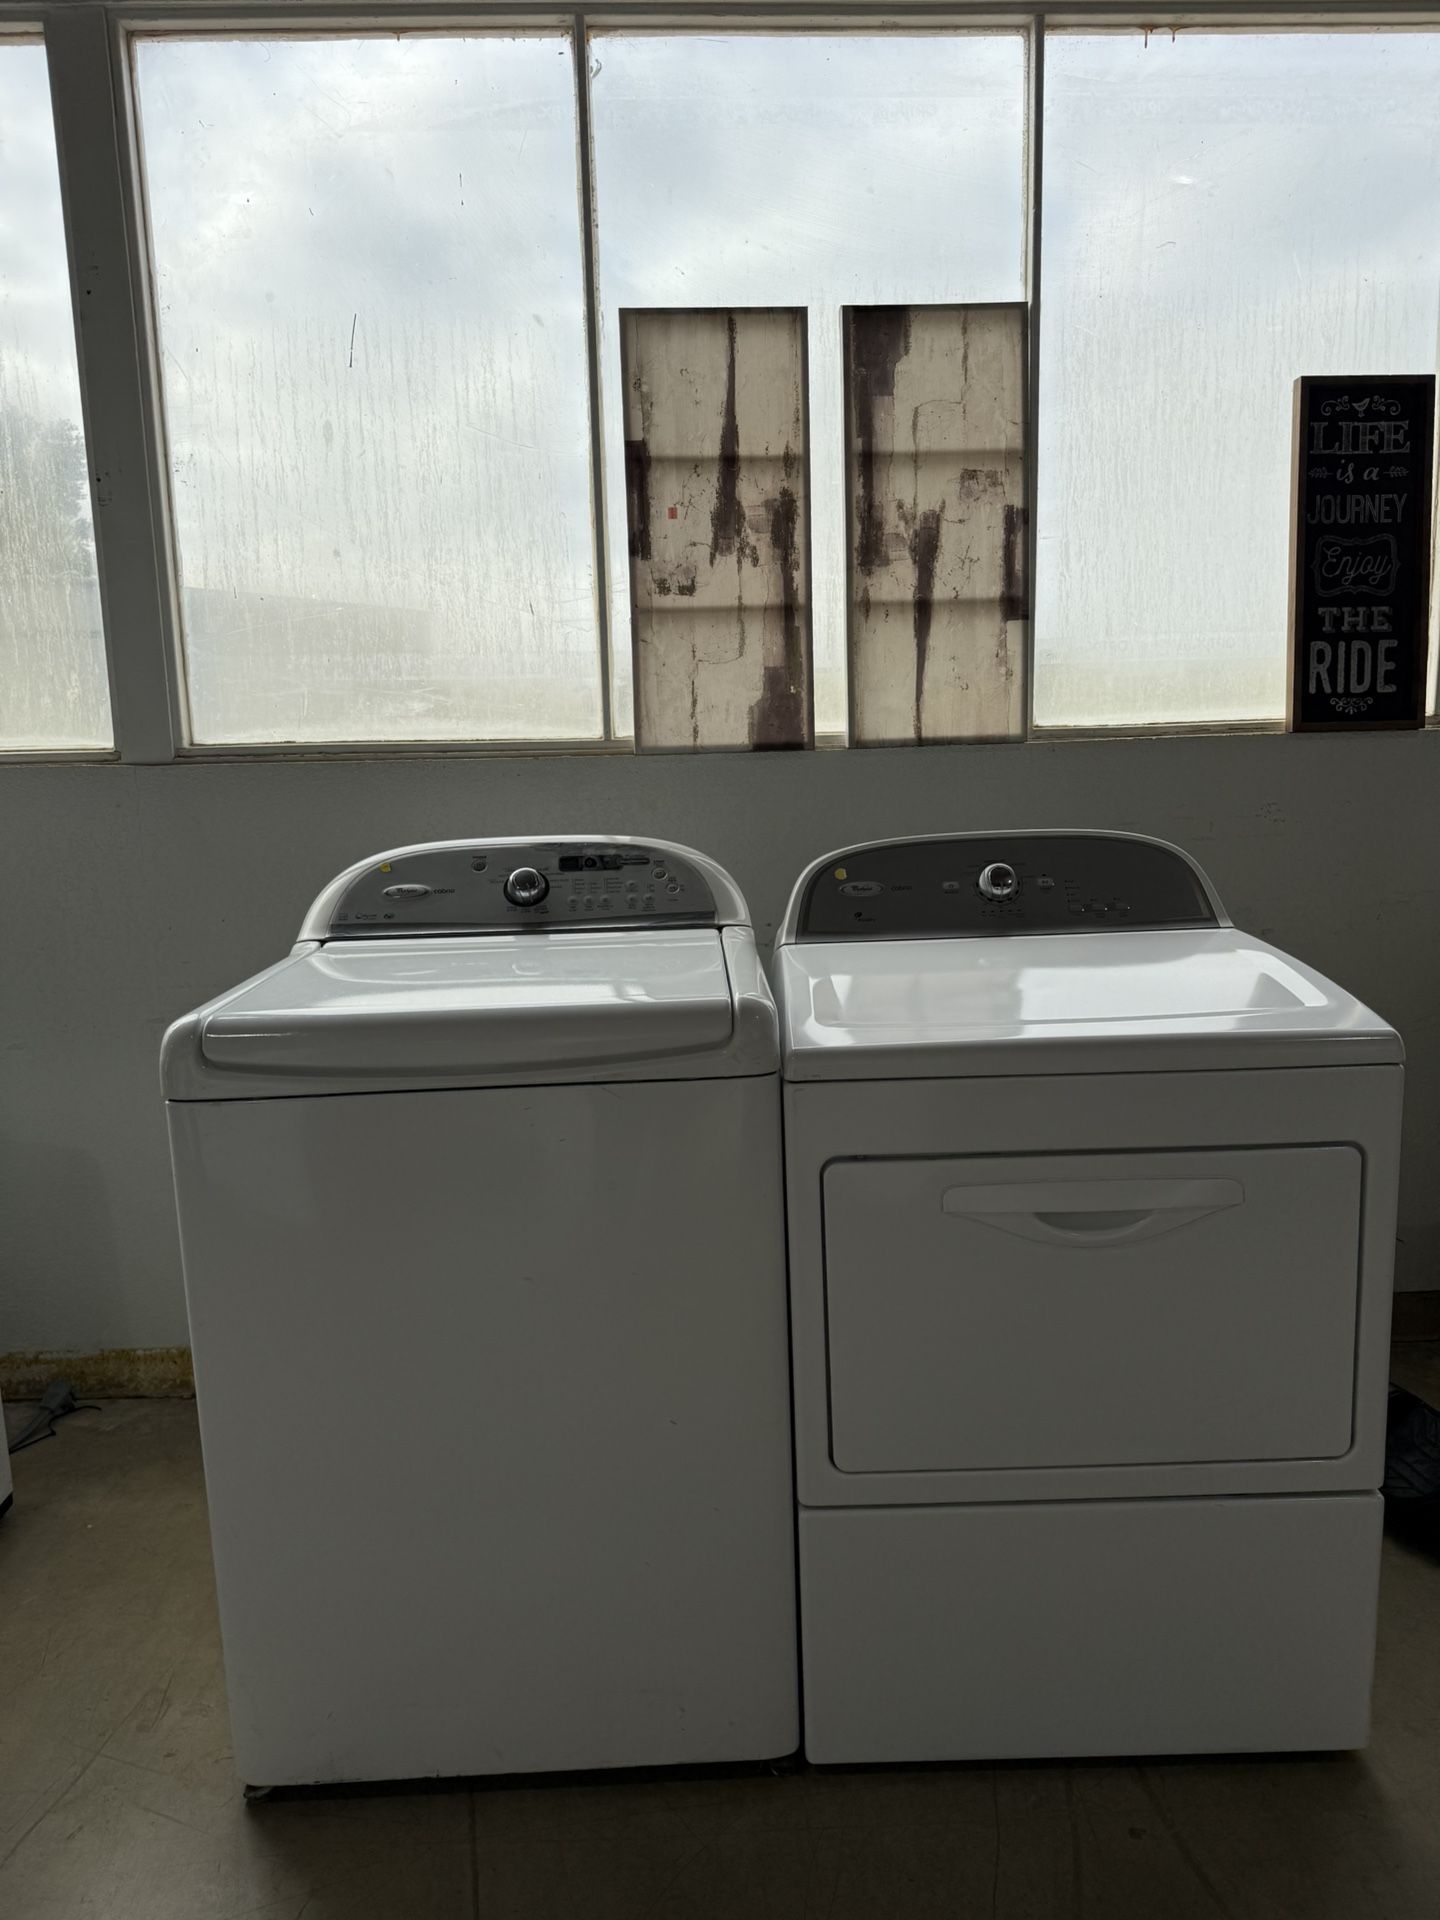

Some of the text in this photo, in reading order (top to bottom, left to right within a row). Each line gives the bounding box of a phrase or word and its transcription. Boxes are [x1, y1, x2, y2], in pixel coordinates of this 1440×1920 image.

[1309, 420, 1411, 455] LIFE
[1336, 459, 1380, 484] is a
[1307, 493, 1408, 524] JOURNEY
[1322, 546, 1392, 585] Enjoy
[1318, 606, 1393, 634] THE
[1308, 639, 1399, 694] RIDE
